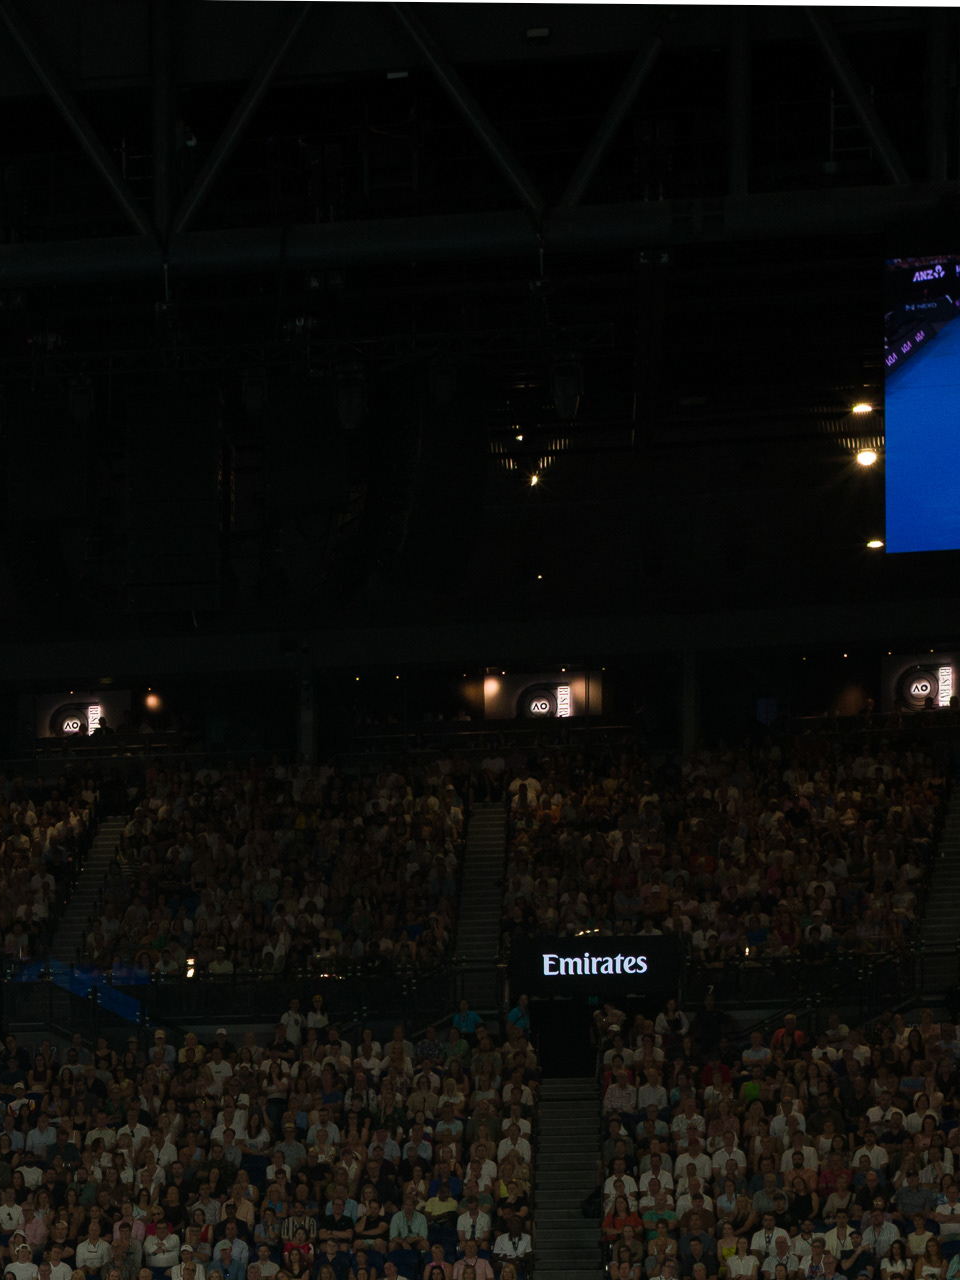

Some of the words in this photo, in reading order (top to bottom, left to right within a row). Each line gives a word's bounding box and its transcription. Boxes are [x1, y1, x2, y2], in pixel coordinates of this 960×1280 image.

[912, 269, 934, 283] ANZ
[913, 684, 928, 693] AO
[532, 702, 548, 710] AO
[64, 721, 79, 730] AO
[542, 951, 648, 977] Emirates
